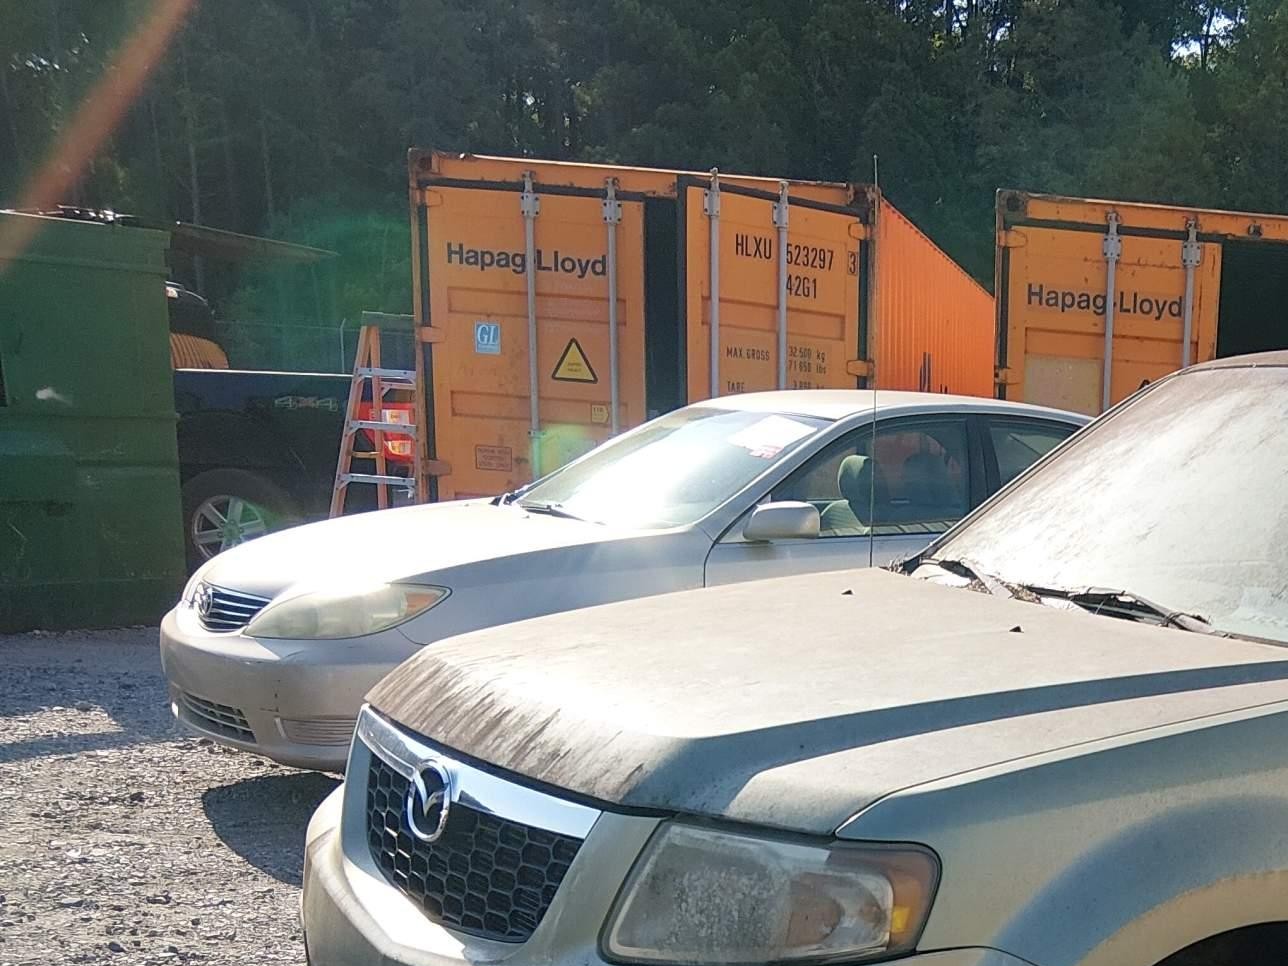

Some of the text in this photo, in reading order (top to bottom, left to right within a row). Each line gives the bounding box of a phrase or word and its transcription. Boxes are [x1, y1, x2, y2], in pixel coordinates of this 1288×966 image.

[446, 242, 607, 279] HapagLloyd
[735, 233, 857, 274] HLXU 523297 3
[786, 275, 817, 299] 42G1
[477, 324, 498, 345] GL
